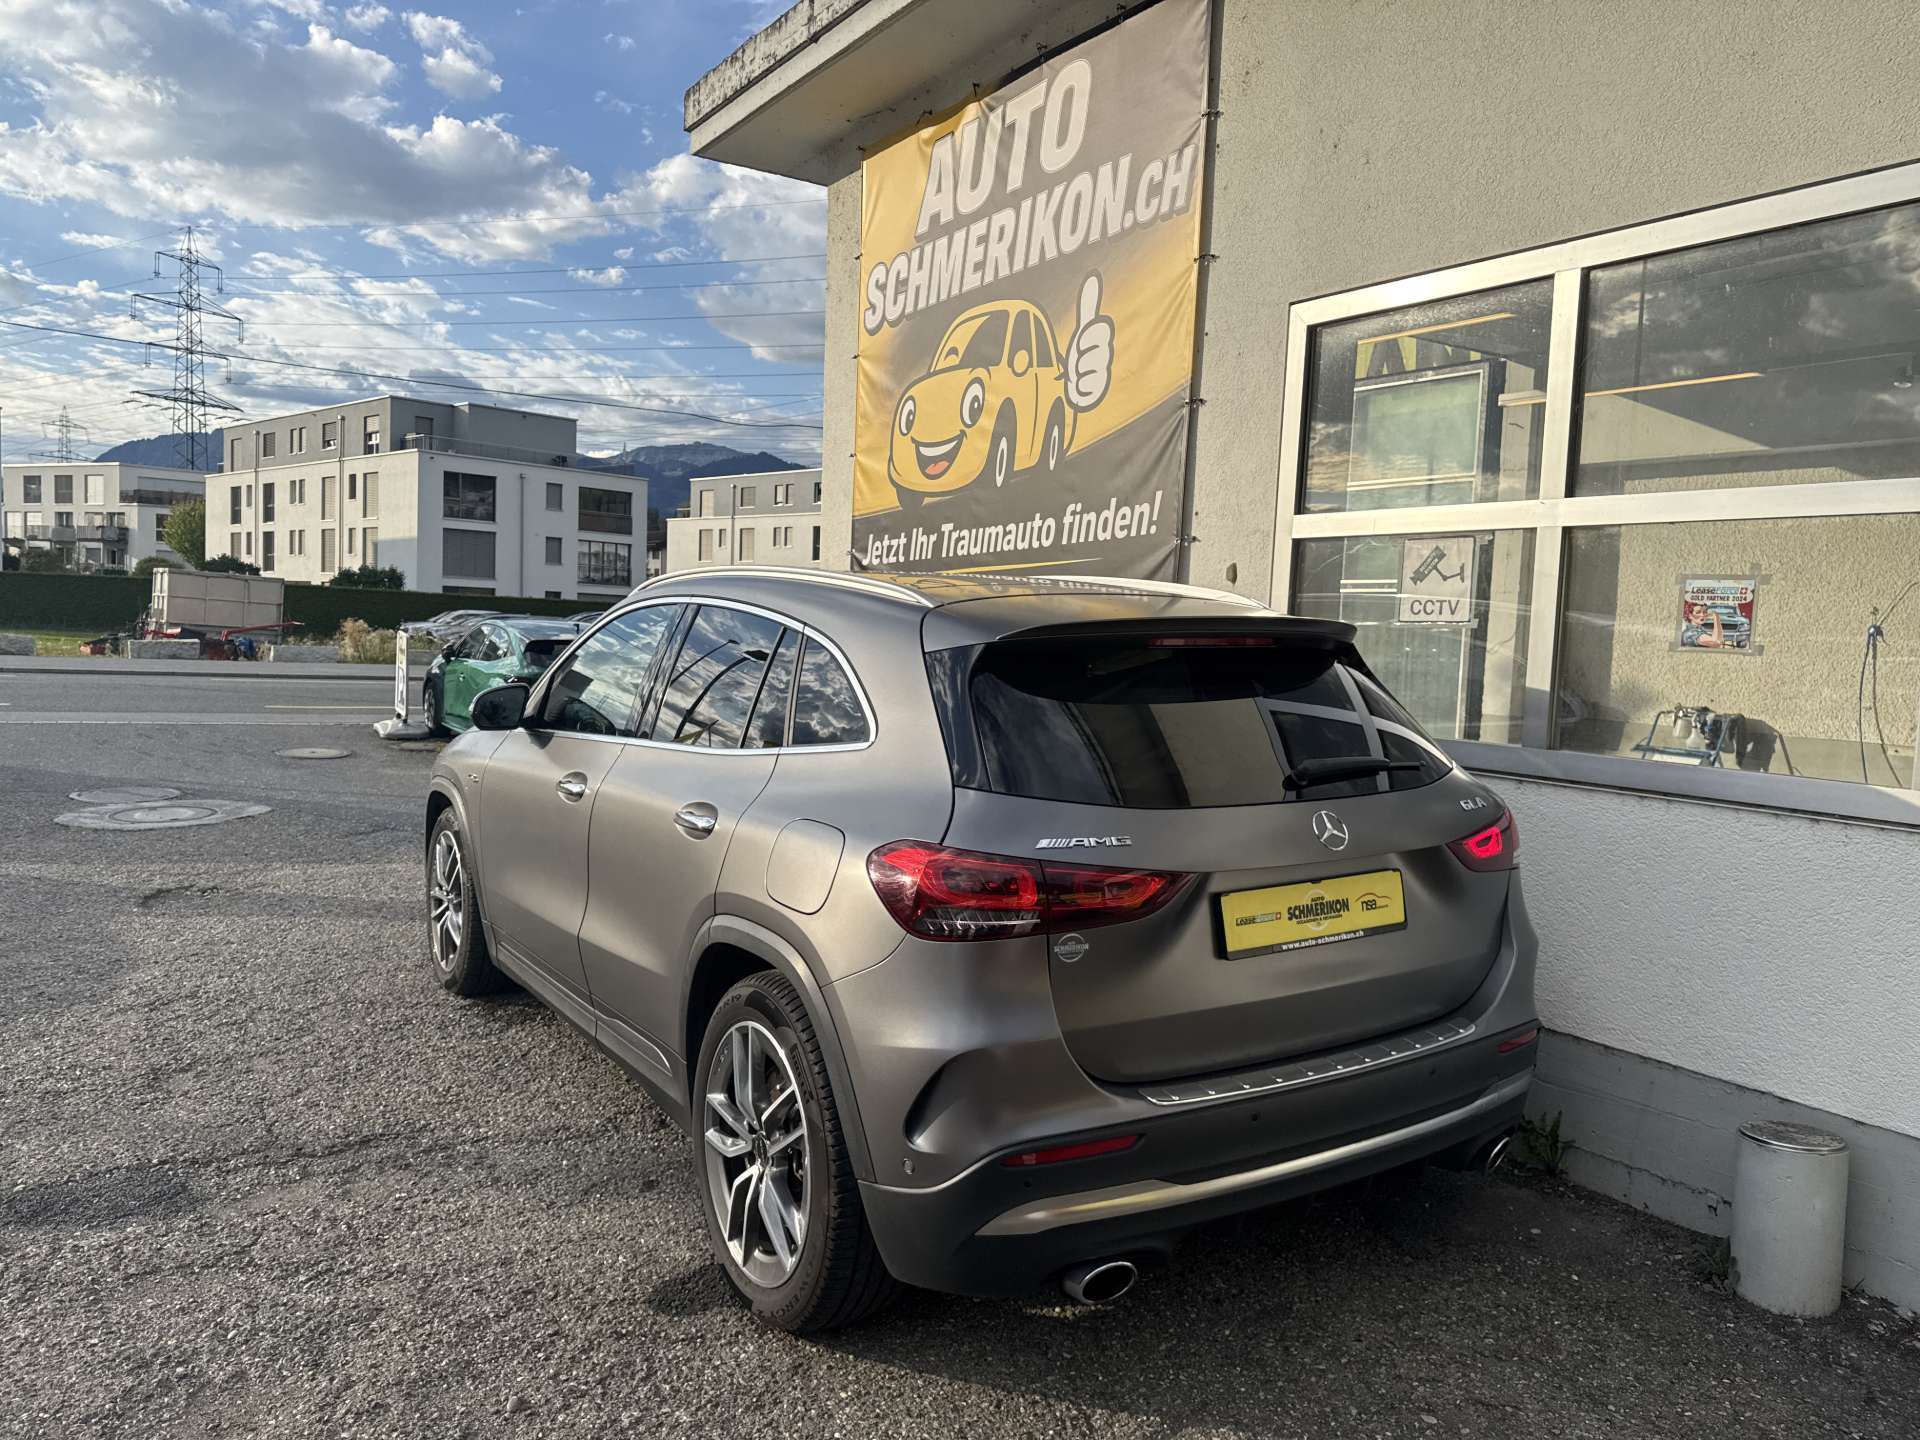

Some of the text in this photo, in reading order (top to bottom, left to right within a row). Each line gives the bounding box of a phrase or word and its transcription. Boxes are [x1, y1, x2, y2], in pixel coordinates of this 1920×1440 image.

[915, 58, 1092, 238] AUTO
[864, 143, 1197, 332] SCHMERIKON.CH
[861, 490, 1164, 566] Jetzt Ihr Traumauto finden!
[1410, 600, 1460, 615] CCTV
[1067, 836, 1133, 849] AMG
[1287, 898, 1350, 921] SCHMERIKON
